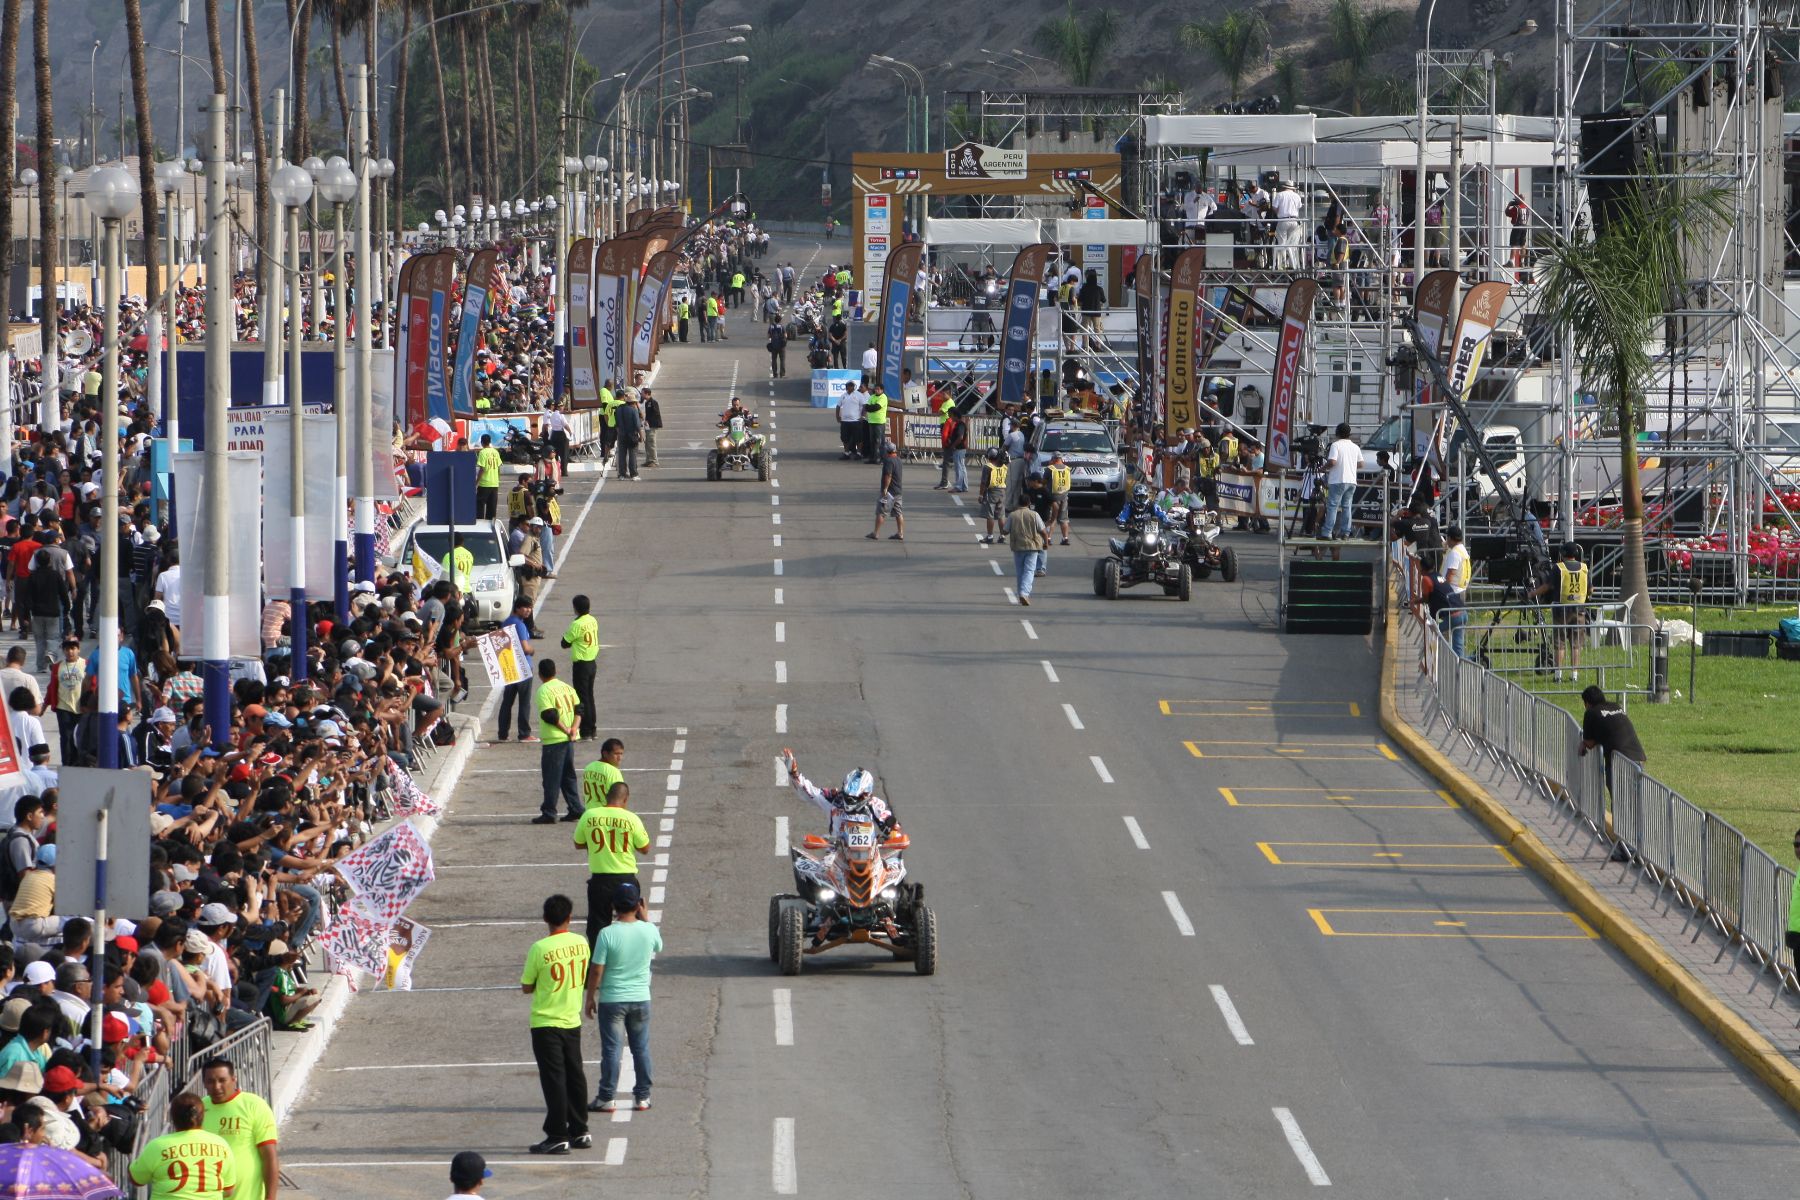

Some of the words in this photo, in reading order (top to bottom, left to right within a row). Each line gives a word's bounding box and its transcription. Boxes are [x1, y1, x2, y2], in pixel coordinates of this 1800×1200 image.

[1472, 306, 1491, 321] DAKAR
[603, 297, 615, 373] sodexo
[886, 302, 904, 378] Macro
[427, 313, 443, 397] Macro
[1171, 300, 1189, 395] Comercio
[1008, 360, 1021, 368] FOX
[1276, 331, 1299, 426] TOTAL
[234, 424, 265, 436] PARA
[914, 426, 941, 435] MICHE
[1569, 573, 1581, 583] TV
[1569, 584, 1581, 593] 23
[480, 637, 500, 684] DAKAR
[583, 781, 608, 803] 911
[587, 817, 635, 832] SECURITY
[591, 828, 629, 854] 911
[851, 836, 869, 845] 262
[550, 958, 587, 993] 911
[220, 1117, 241, 1130] 911
[166, 1158, 224, 1194] 911
